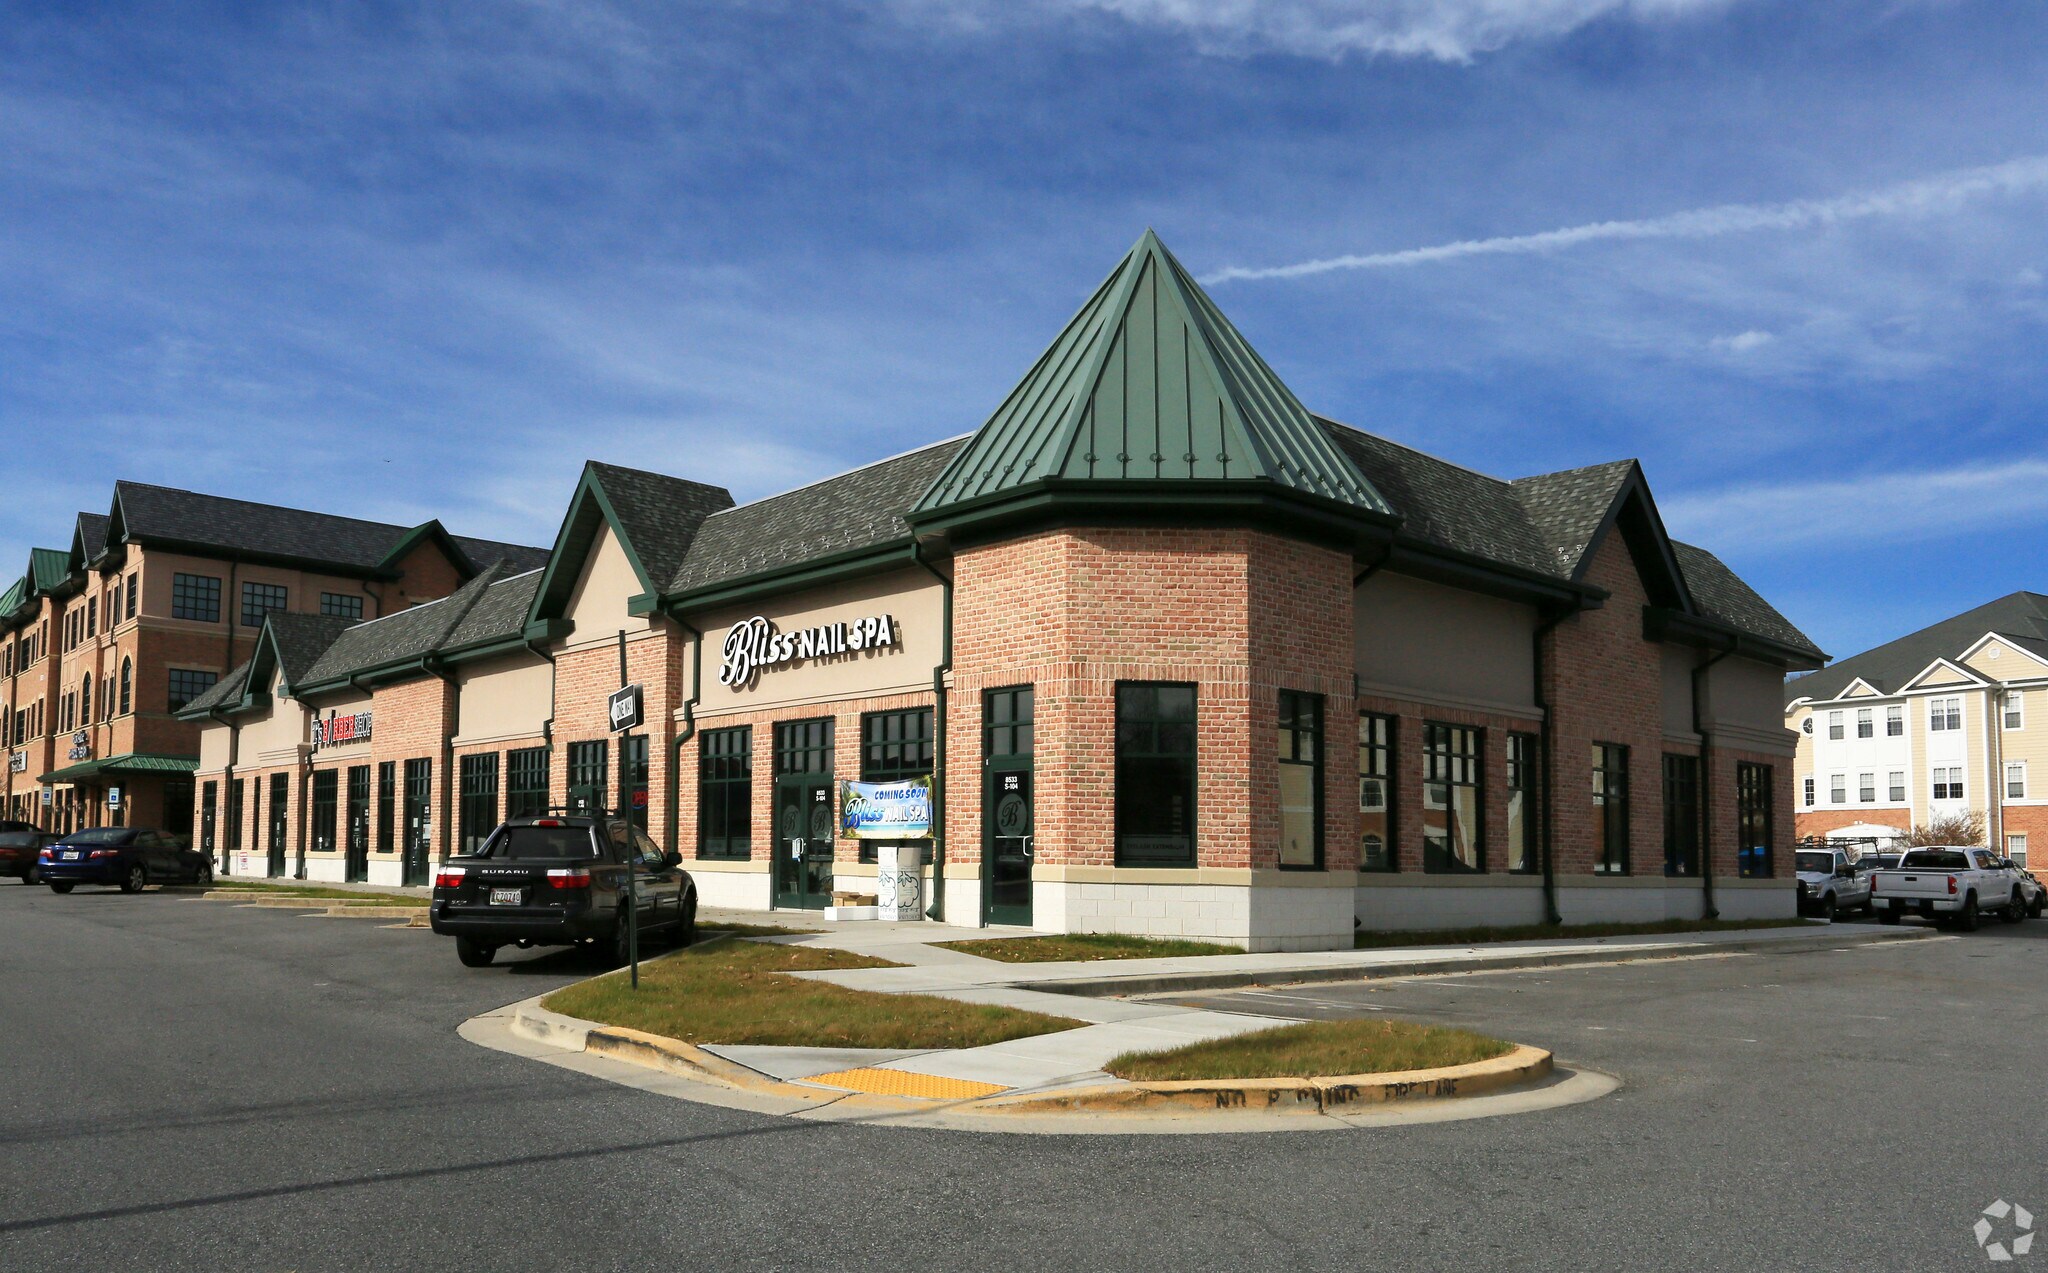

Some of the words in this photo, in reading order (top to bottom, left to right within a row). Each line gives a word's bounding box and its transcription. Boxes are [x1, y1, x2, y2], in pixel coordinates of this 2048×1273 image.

[718, 615, 797, 686] Bliss
[800, 622, 847, 659] NAIL
[848, 614, 894, 651] SPA
[874, 789, 904, 801] COMING
[905, 786, 929, 799] SOON
[843, 797, 885, 829] Bliss
[885, 805, 909, 822] NAIL
[909, 804, 928, 822] SPA
